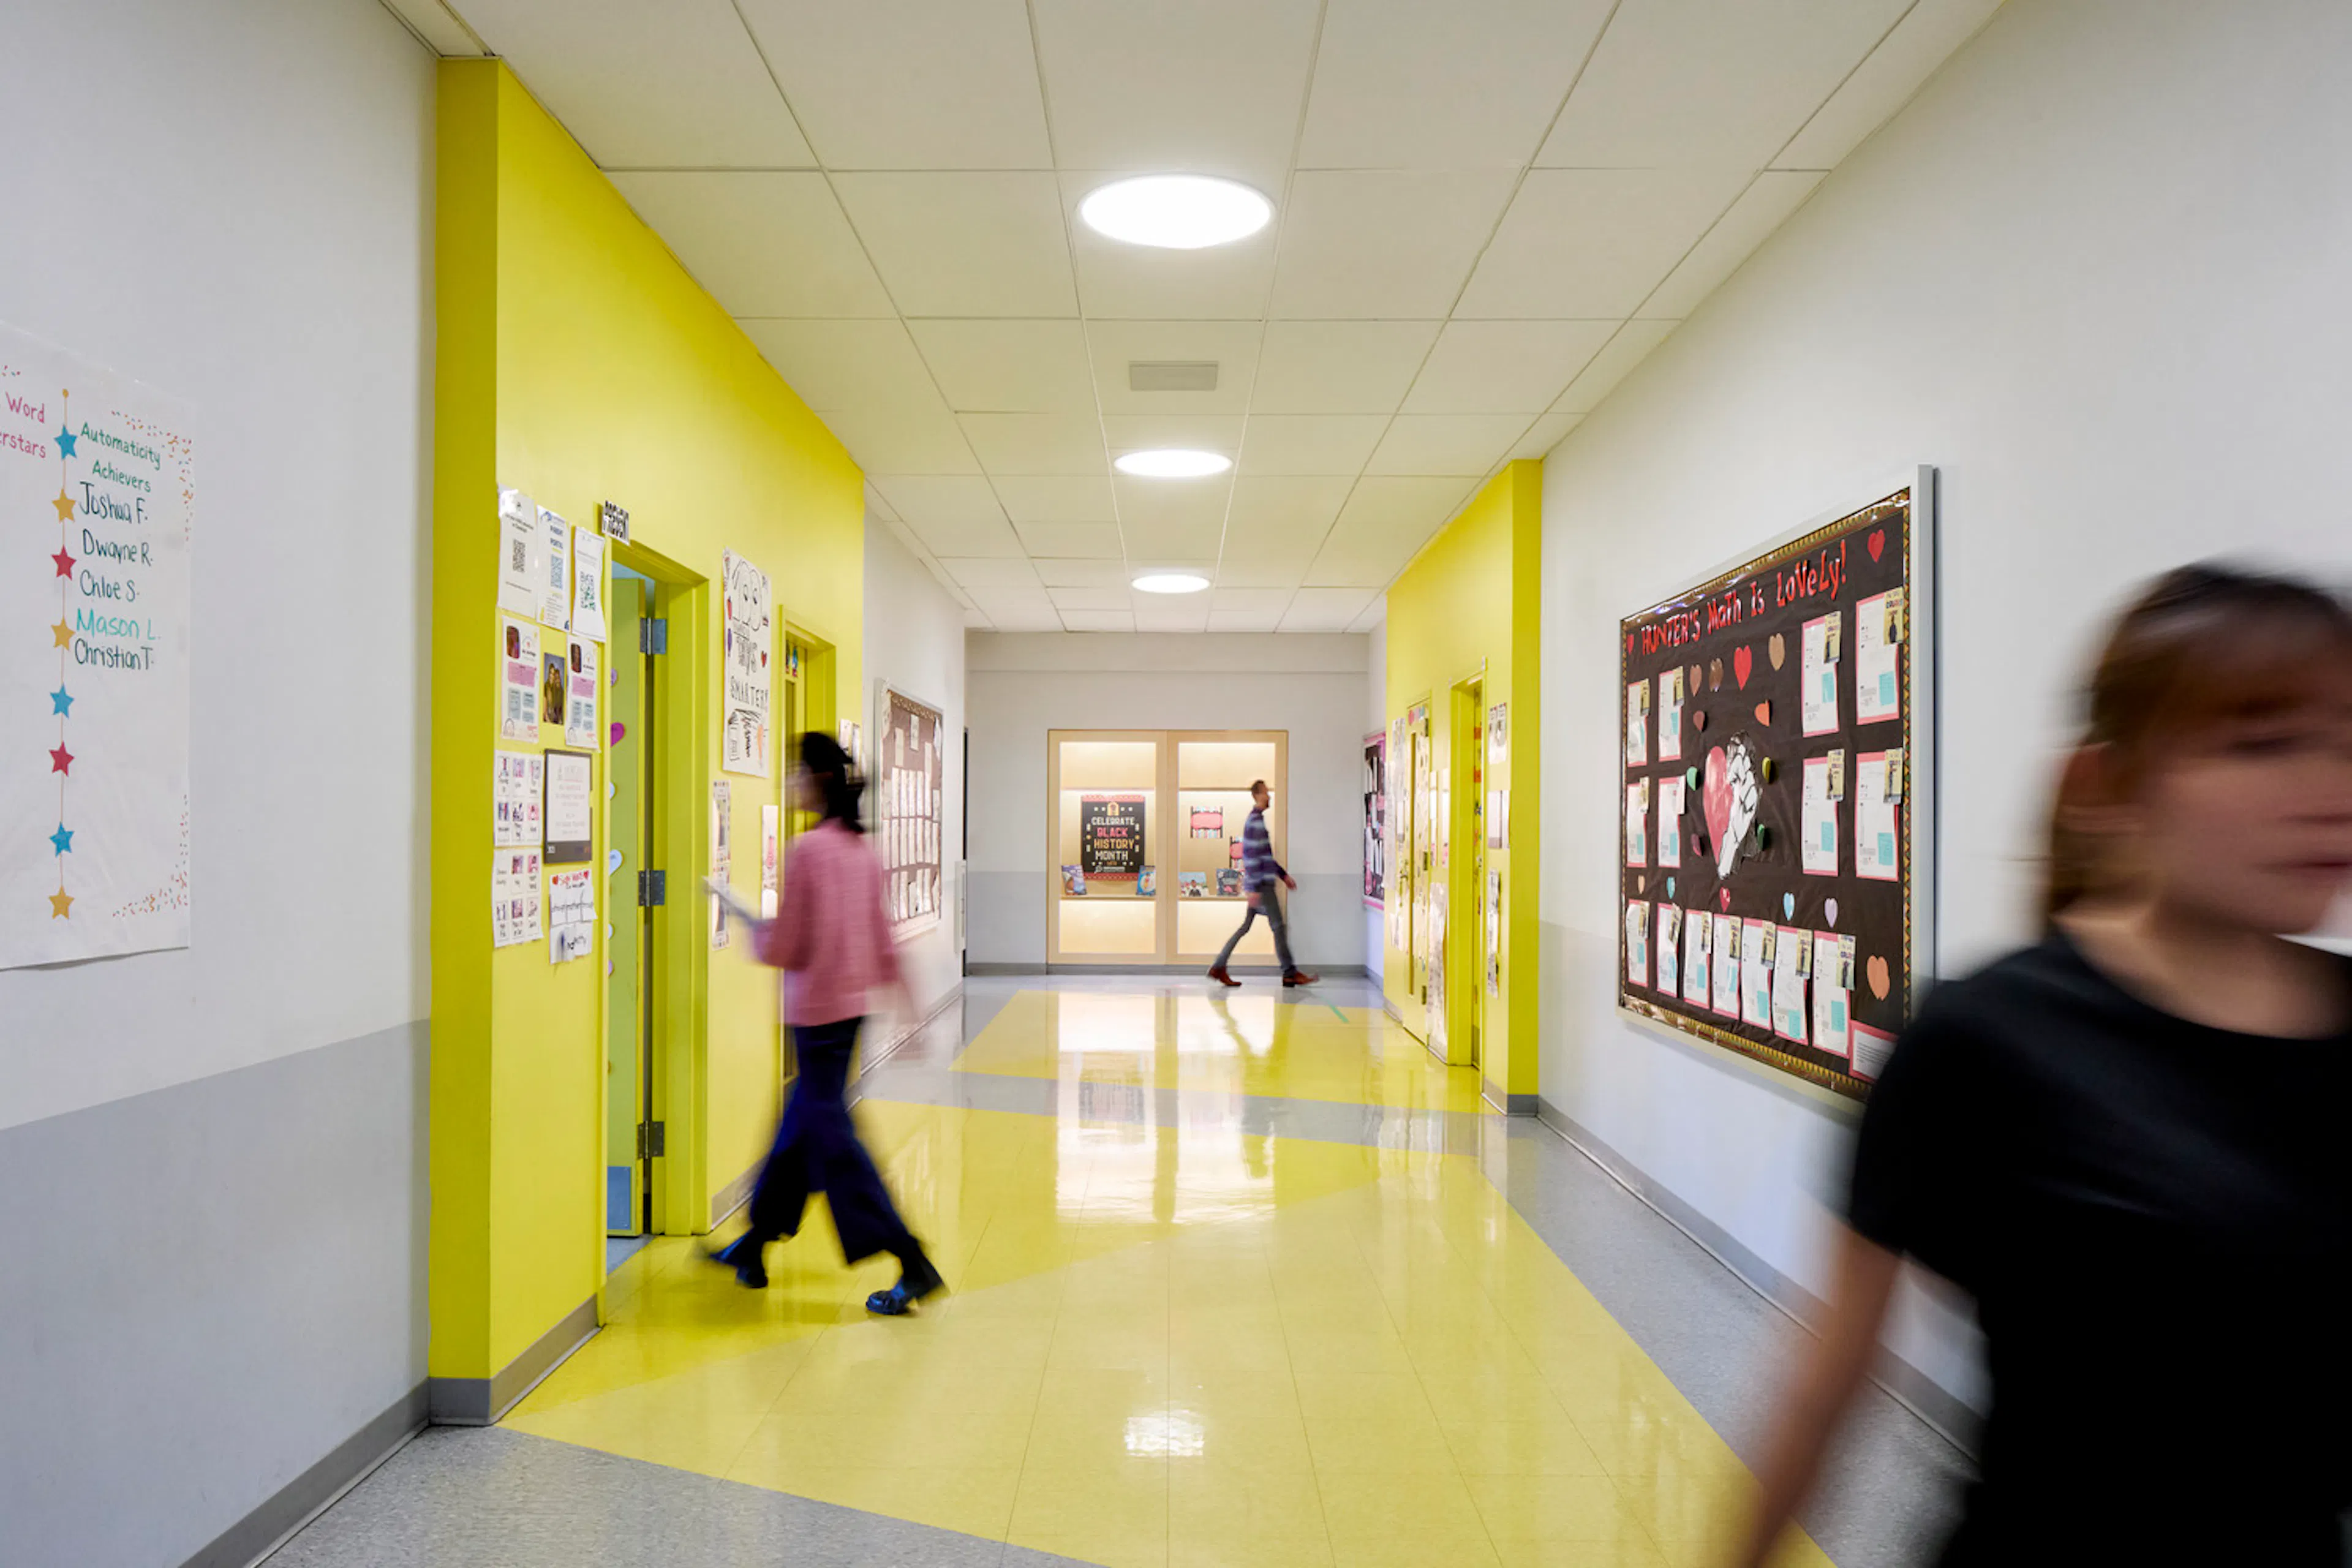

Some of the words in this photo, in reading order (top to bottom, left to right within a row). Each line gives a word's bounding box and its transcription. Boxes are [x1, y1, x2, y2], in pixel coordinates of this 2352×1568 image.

[6, 391, 45, 424] Word
[0, 431, 46, 459] rstars
[80, 421, 160, 471] Automaticity
[92, 459, 151, 492] Achievers
[79, 481, 132, 524] Joshua
[137, 497, 148, 524] F.
[83, 528, 137, 564] Dwayne
[141, 542, 153, 567] R.
[80, 570, 121, 600] Chloe
[126, 579, 140, 602] S.
[77, 607, 140, 639] Mason
[1641, 608, 1700, 656] HUNTER'S
[75, 638, 141, 670] Christian
[140, 646, 154, 670] T.
[1091, 816, 1135, 826] CELEBRATE
[1096, 827, 1128, 838] BLACK
[1094, 838, 1134, 850] HISTORY
[1095, 850, 1128, 861] MONTH
